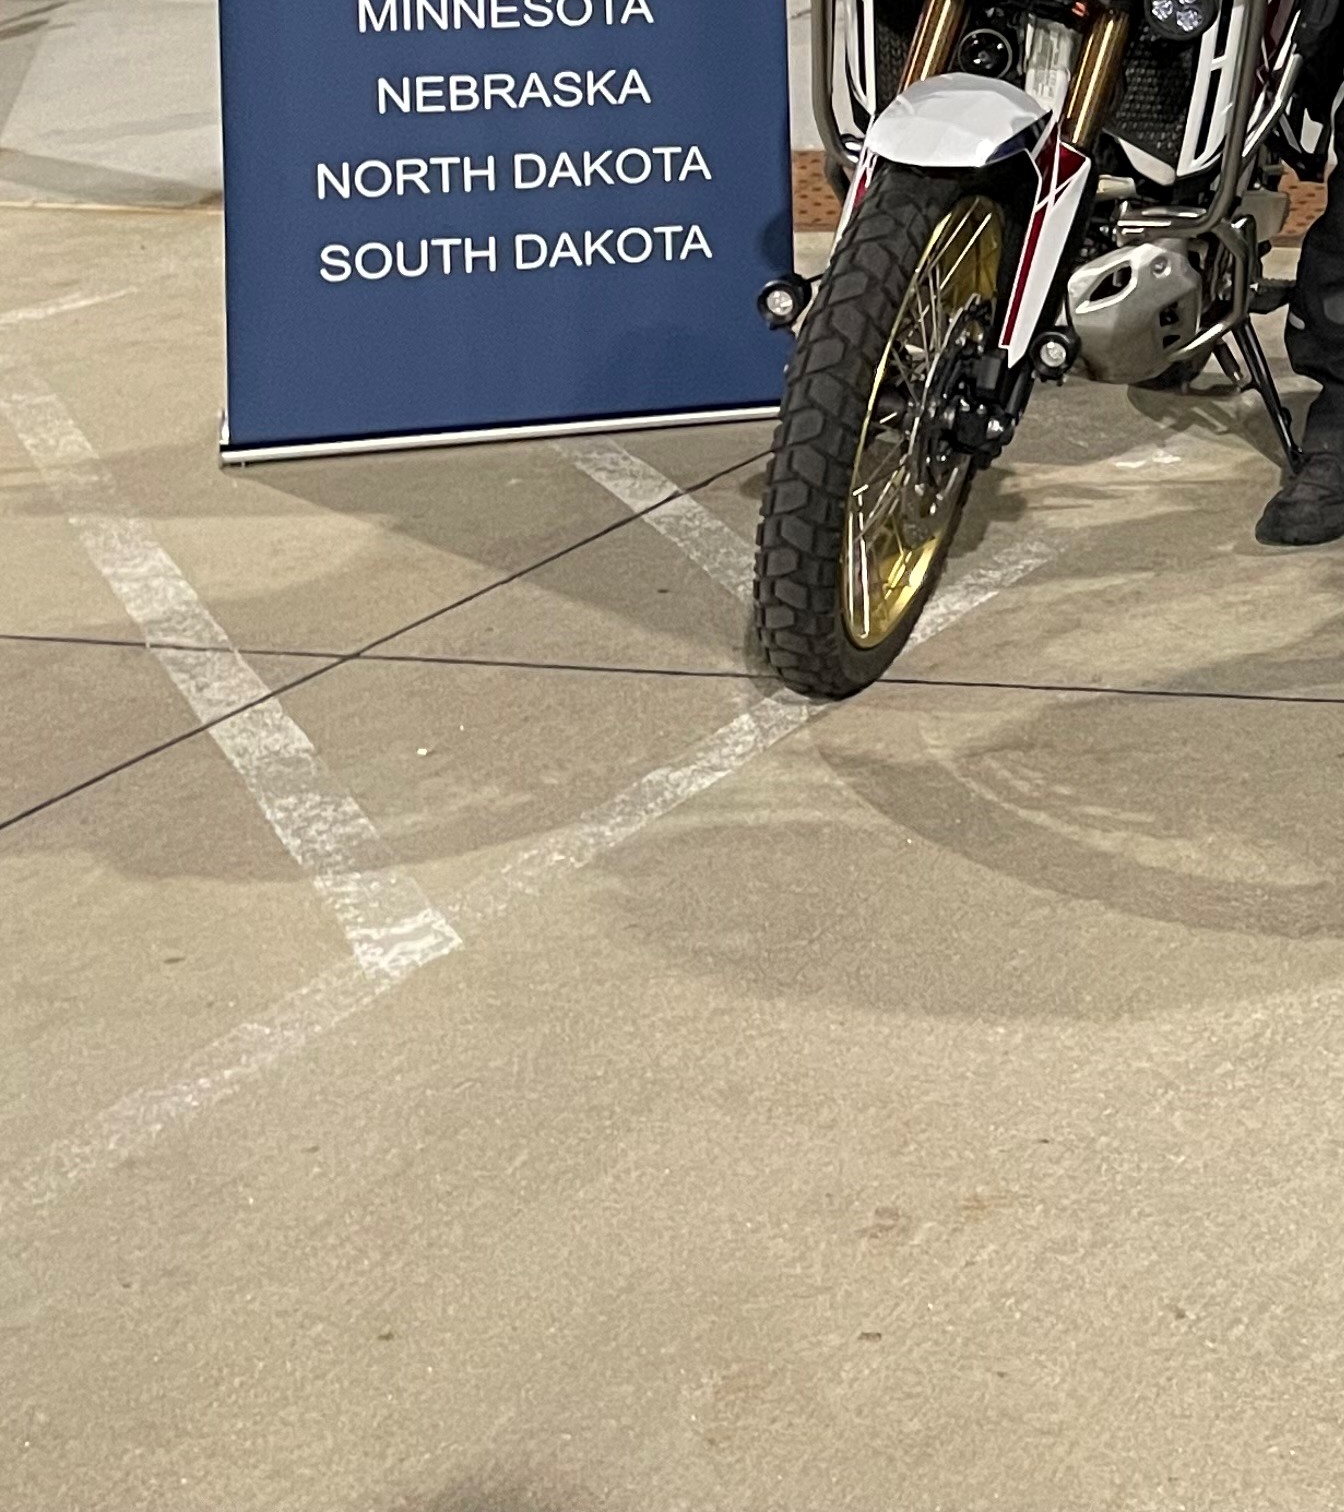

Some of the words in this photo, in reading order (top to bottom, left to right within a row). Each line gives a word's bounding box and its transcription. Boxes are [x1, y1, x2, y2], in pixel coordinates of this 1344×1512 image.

[377, 68, 652, 115] NEBRASKA
[316, 154, 496, 200] NORTH
[513, 145, 712, 190] DAKOTA
[319, 235, 497, 283] SOUTH
[514, 224, 713, 270] DAKOTA
